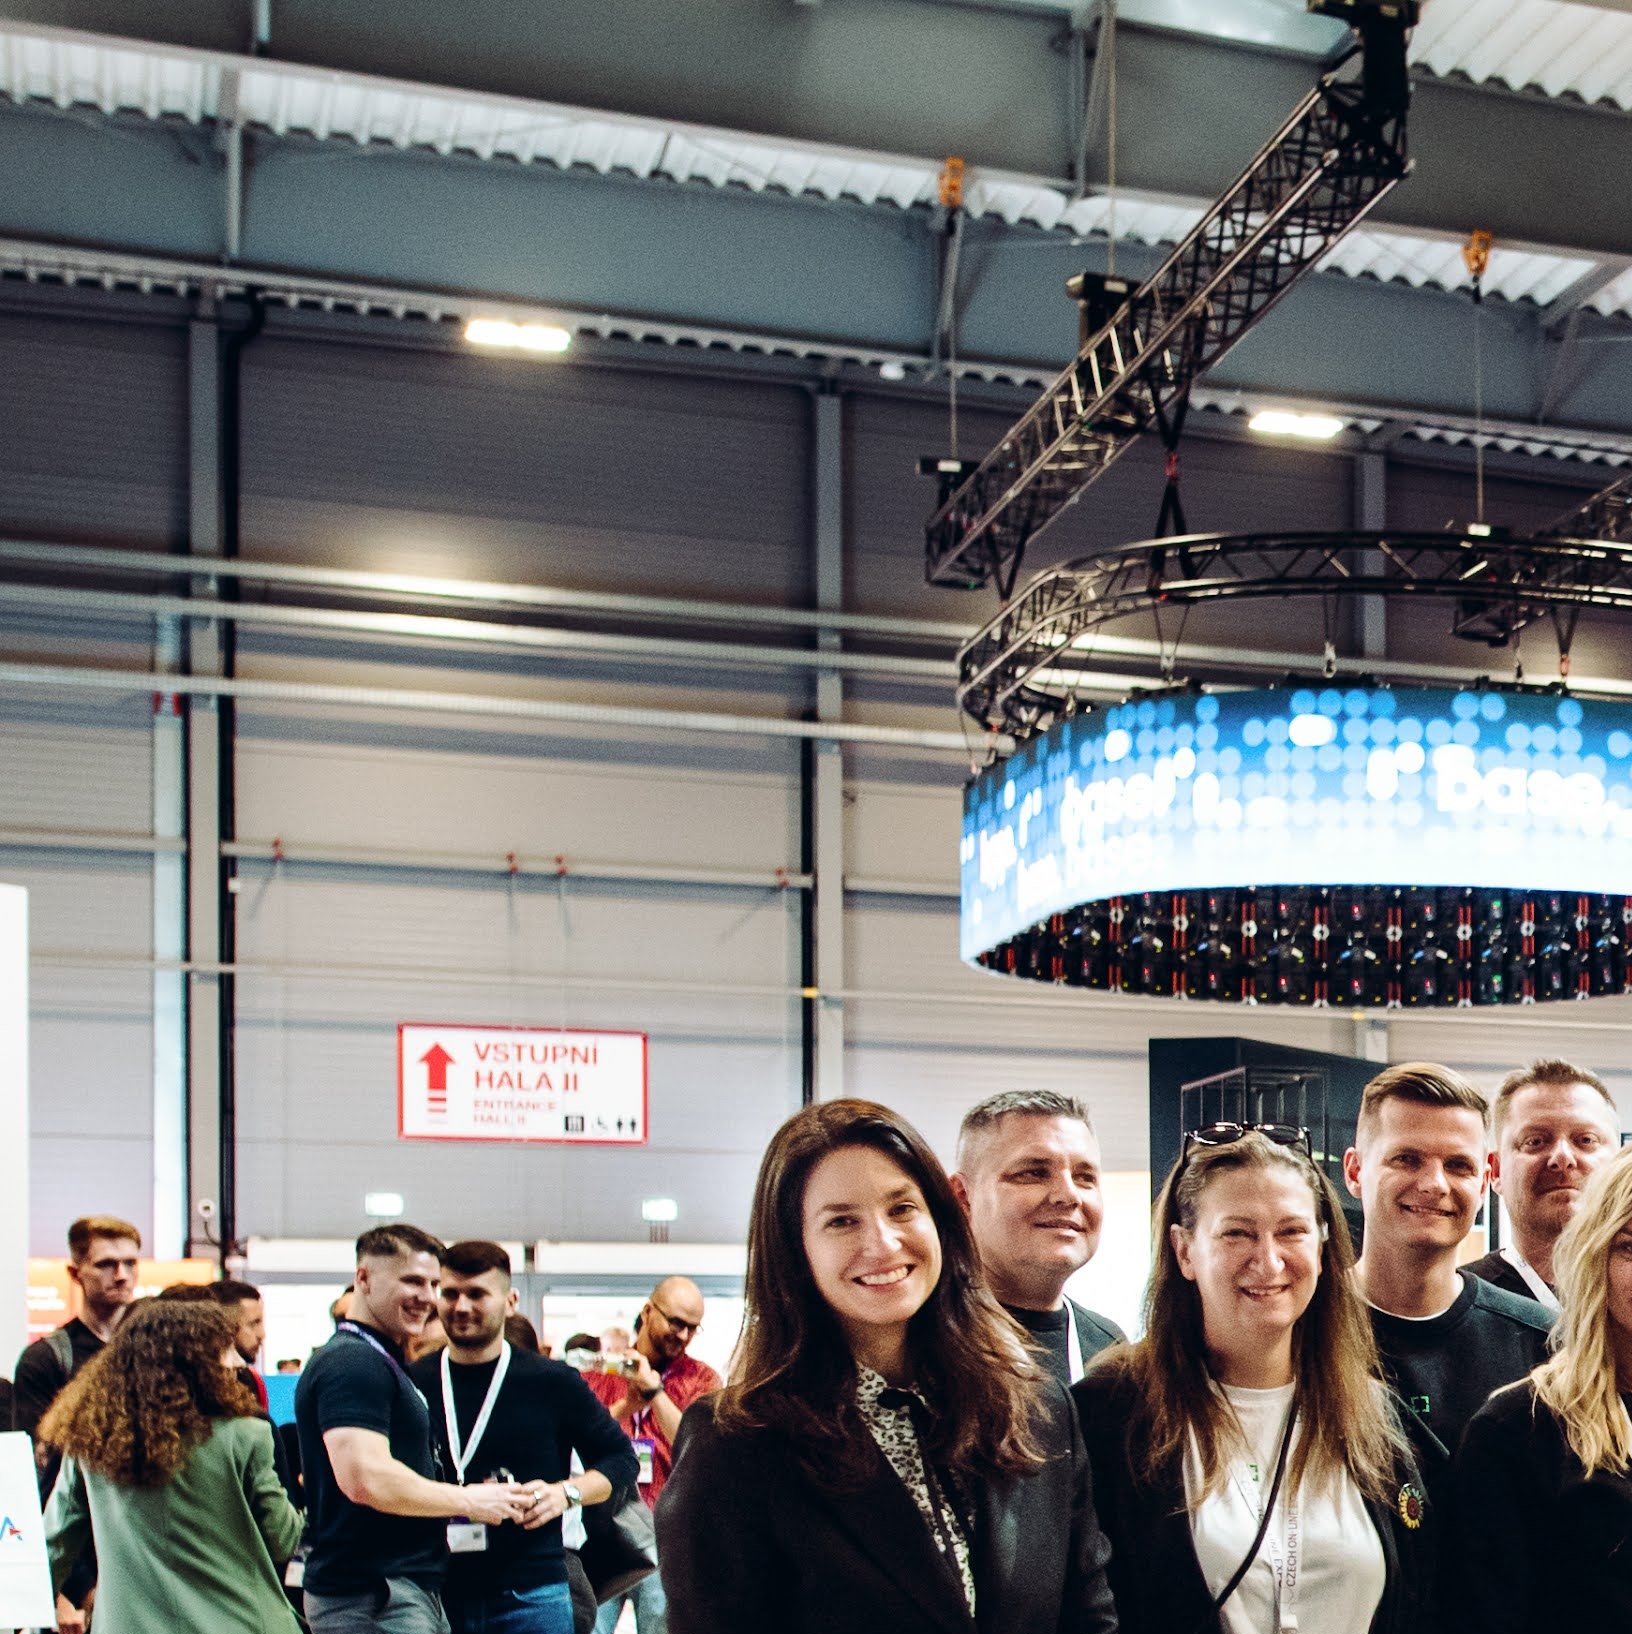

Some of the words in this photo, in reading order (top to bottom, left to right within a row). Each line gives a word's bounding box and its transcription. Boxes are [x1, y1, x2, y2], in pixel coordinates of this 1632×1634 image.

[475, 1040, 598, 1065] VSTUPNÍ
[475, 1071, 553, 1092] HALA
[474, 1099, 557, 1113] ENTRANCE
[1286, 1558, 1298, 1588] CZECH
